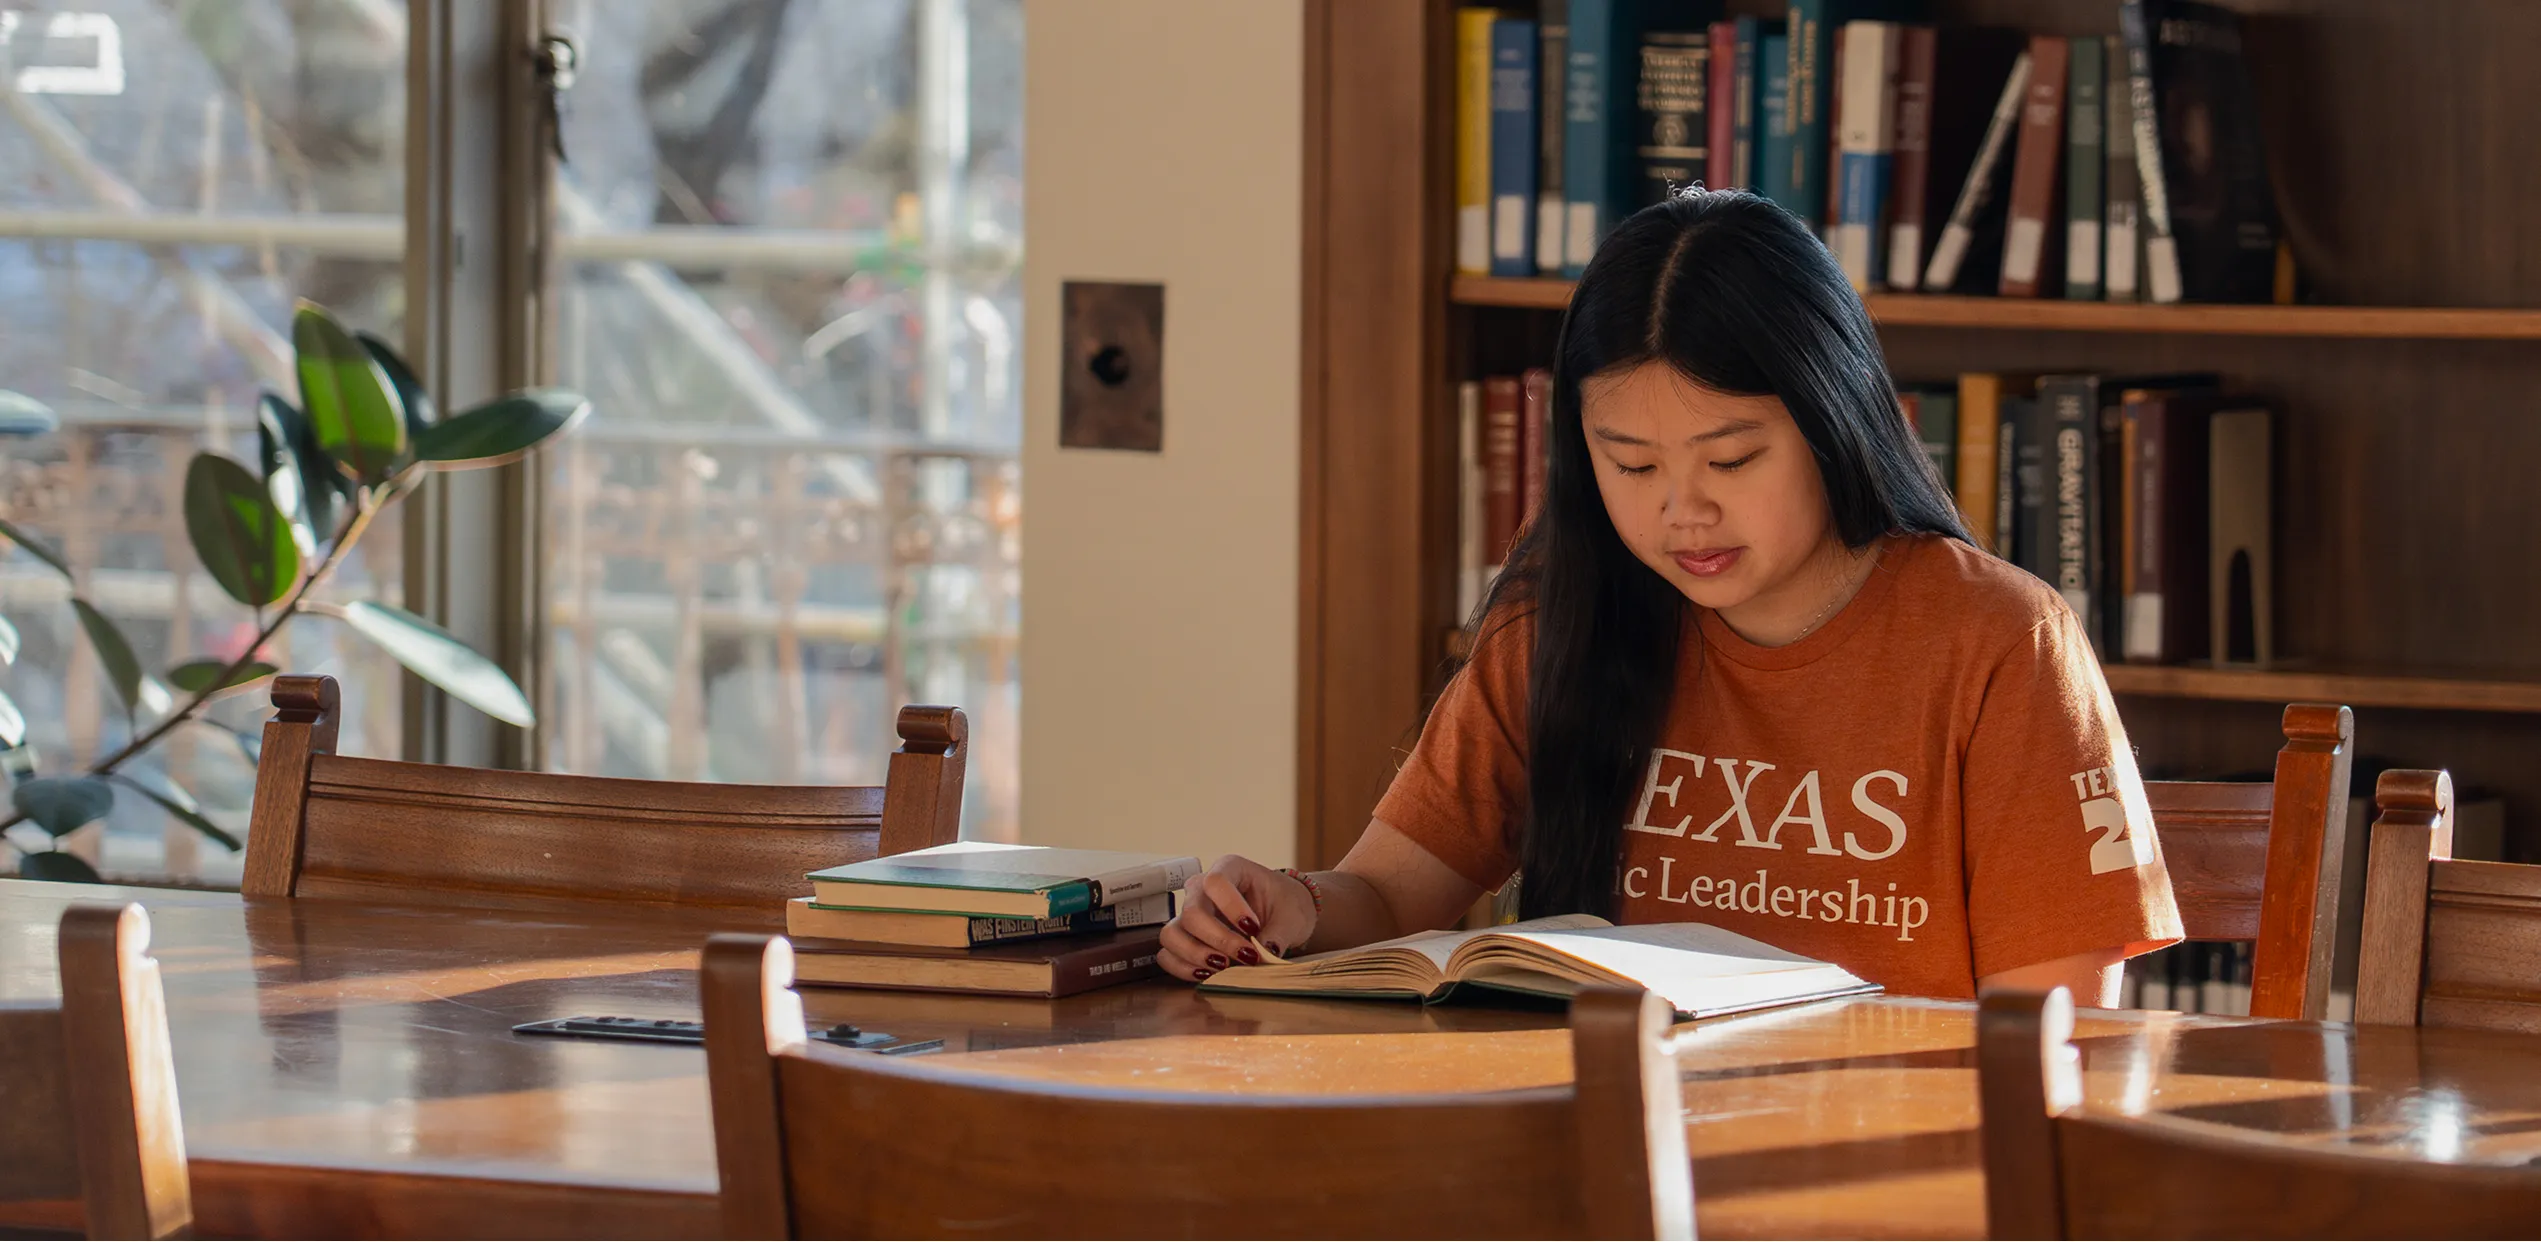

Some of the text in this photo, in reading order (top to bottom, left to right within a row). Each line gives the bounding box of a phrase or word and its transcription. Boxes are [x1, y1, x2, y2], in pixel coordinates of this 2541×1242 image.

[2057, 428, 2084, 590] GRAVITATIO
[1623, 748, 1909, 861] EXAS
[971, 918, 994, 942] WAS
[995, 918, 1036, 939] EINSTEIN
[1657, 856, 1930, 942] Leadership
